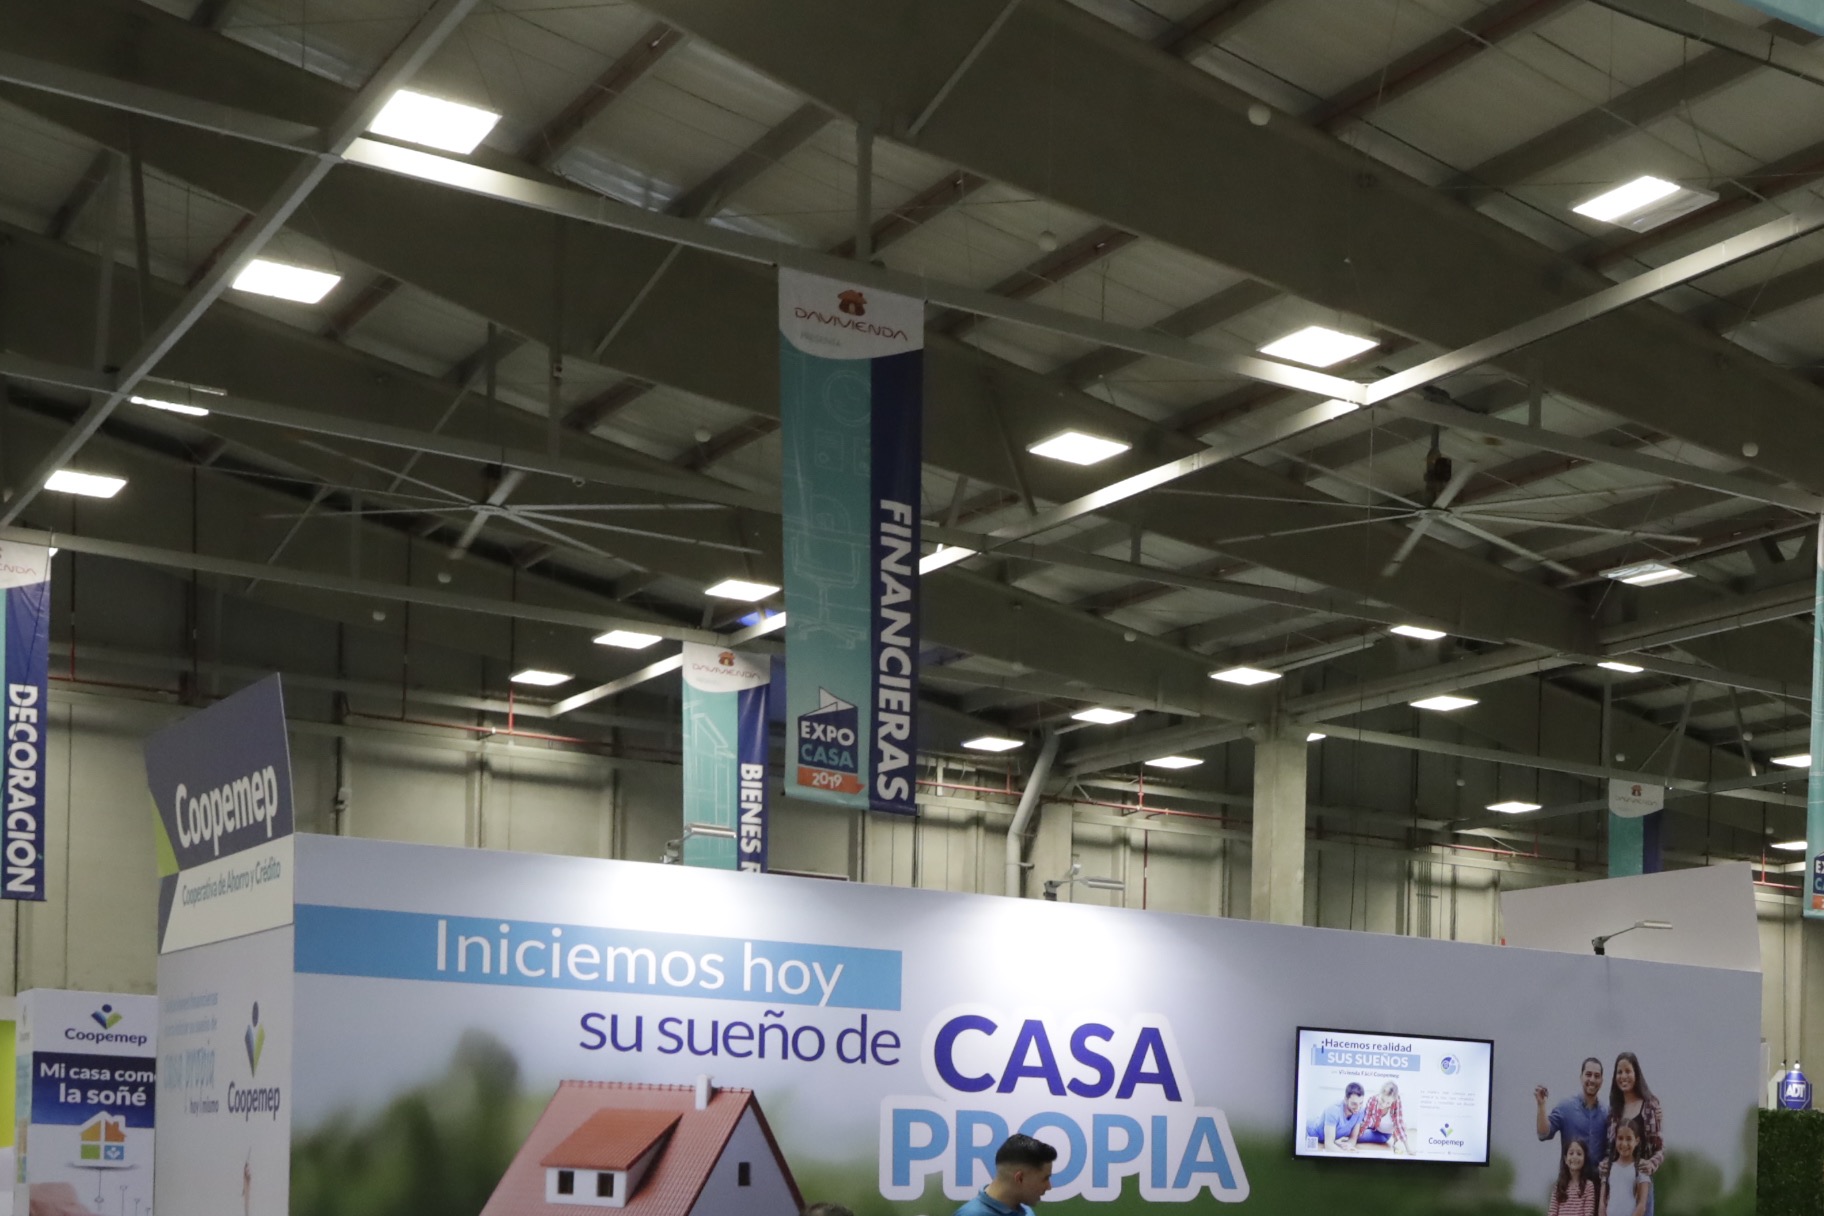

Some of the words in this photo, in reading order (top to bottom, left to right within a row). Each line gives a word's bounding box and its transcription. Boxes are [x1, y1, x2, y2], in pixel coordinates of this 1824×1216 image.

[794, 307, 908, 341] DAVIVIENDA
[877, 500, 912, 801] FINANCIERAS
[801, 721, 855, 746] EXPO
[801, 743, 854, 768] CASA
[812, 771, 842, 788] 2019
[176, 765, 278, 856] Coopemep
[740, 763, 763, 854] BIENES
[436, 919, 725, 990] Iniciemos
[742, 941, 844, 1007] hoy
[65, 1027, 147, 1046] Coopemep
[579, 1012, 643, 1053] su
[657, 1009, 825, 1062] sueño
[836, 1014, 901, 1066] de
[1372, 1043, 1412, 1053] realidad
[934, 1014, 1183, 1102] CASA
[1327, 1052, 1353, 1064] SUS
[1355, 1053, 1408, 1068] SUEÑOS
[40, 1062, 65, 1079] Mi
[69, 1067, 111, 1081] casa
[59, 1083, 81, 1103] la
[87, 1086, 147, 1106] soñé
[228, 1081, 280, 1122] Coopemep
[1786, 1084, 1806, 1098] ADT
[892, 1108, 1238, 1190] PROPIA
[1428, 1137, 1464, 1147] Coopemep
